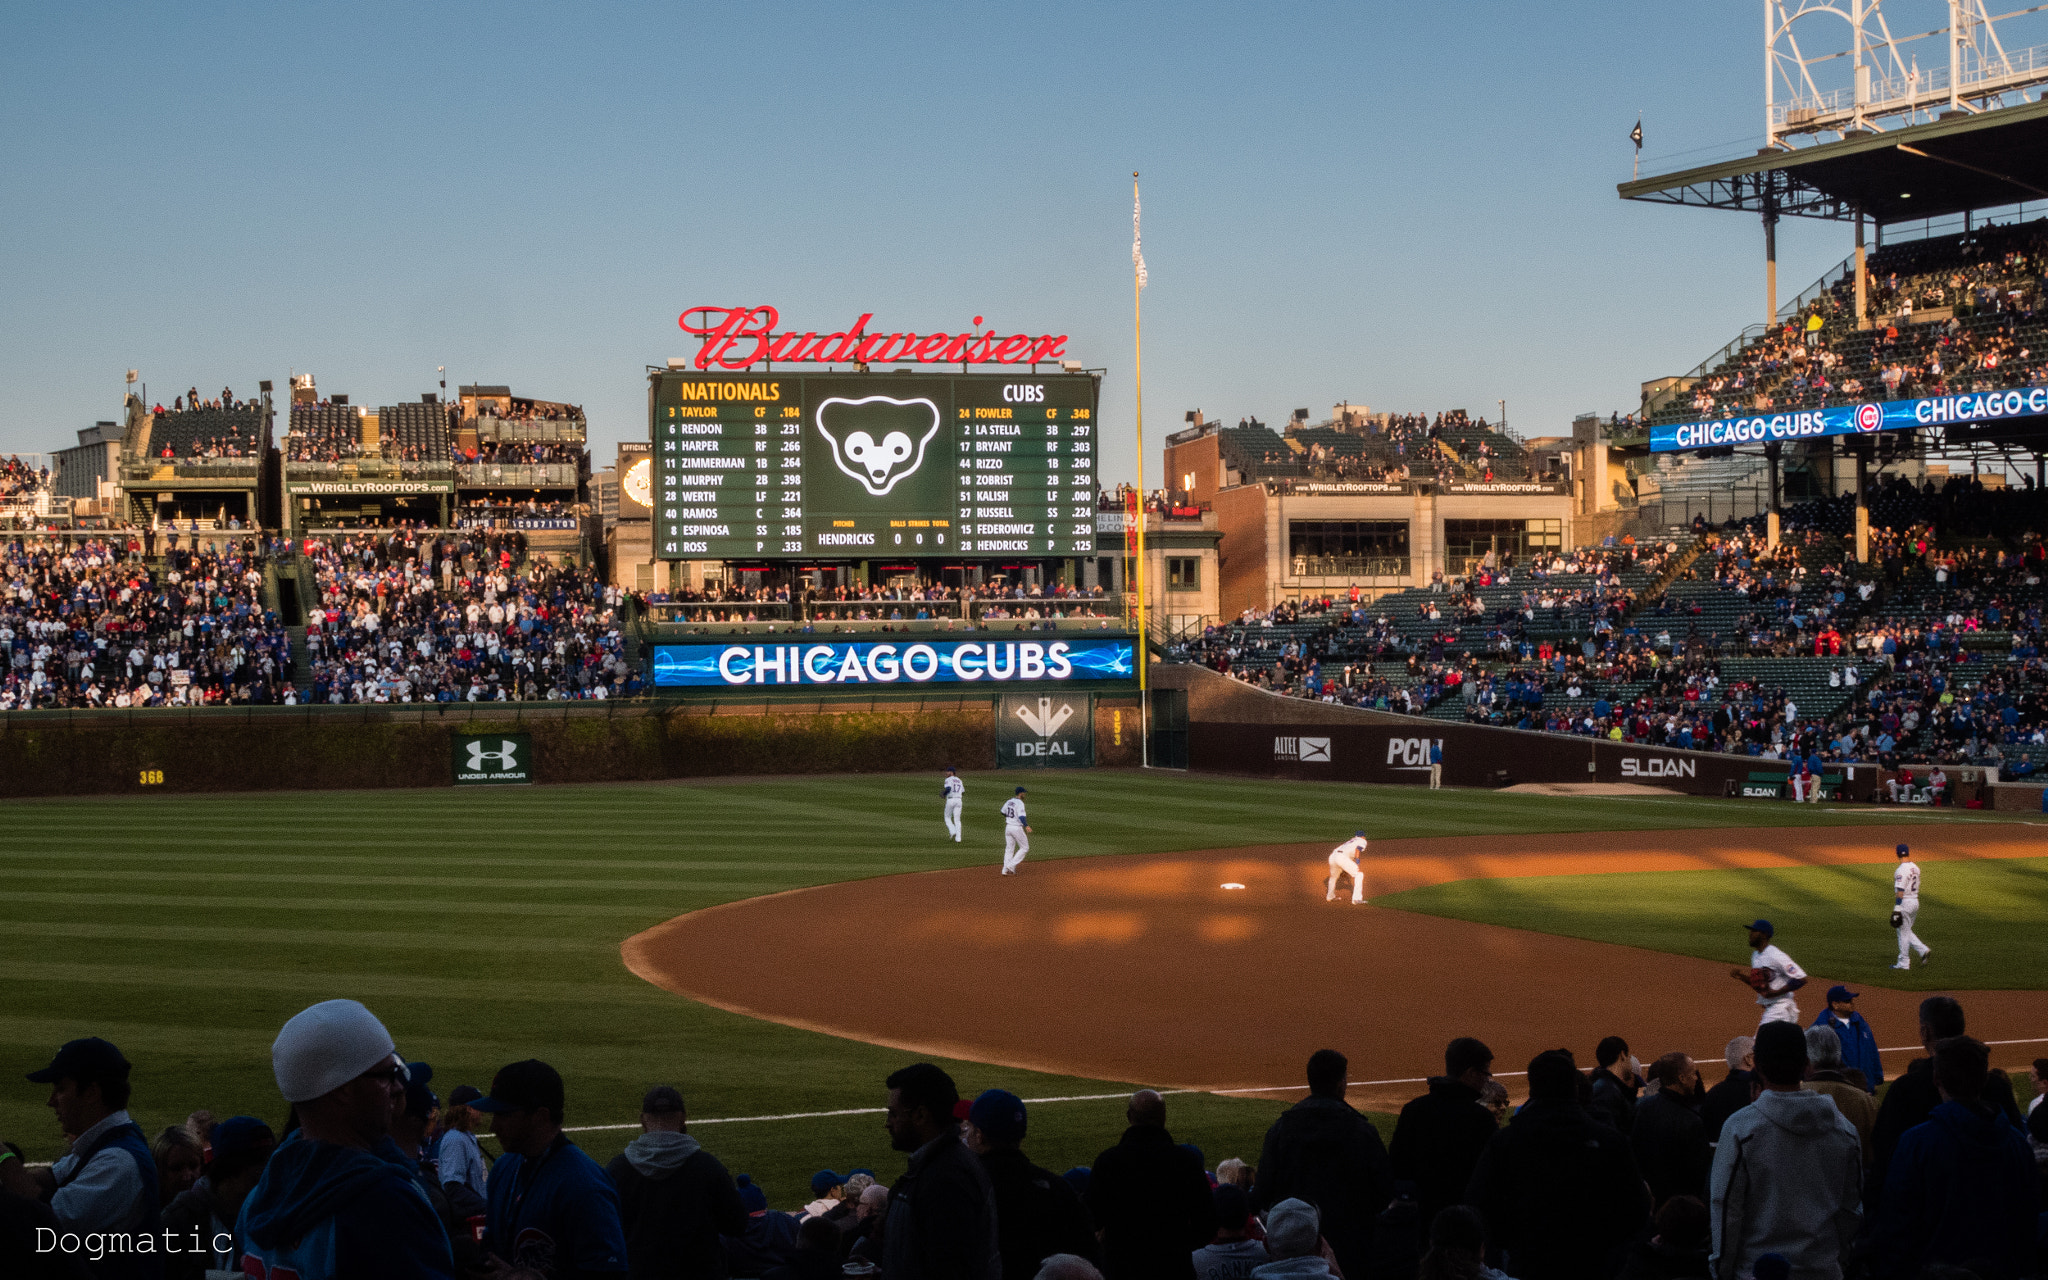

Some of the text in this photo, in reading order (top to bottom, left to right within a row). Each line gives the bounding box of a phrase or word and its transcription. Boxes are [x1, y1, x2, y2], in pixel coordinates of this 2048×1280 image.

[678, 305, 1068, 370] Budweiser
[683, 383, 779, 400] NATIONALS
[1004, 385, 1044, 402] CUBS
[669, 407, 800, 417] 3 TAYLOR CF .184
[1915, 391, 2023, 424] CHICAGO
[959, 408, 1089, 419] 24 FOWLER CF .348
[670, 424, 799, 434] 6 RENDON 3B .231
[965, 425, 1089, 436] 2 LA STELLA 3B .297
[1676, 411, 1825, 447] CHICAGO CUBS
[665, 441, 800, 451] 34 HARPER RF .266
[960, 442, 1090, 452] 17 BRYANT RF .303
[665, 458, 801, 468] 11 ZIMMERMAN 1B .264
[960, 458, 1090, 469] 44 RIZZO 1B .260
[665, 475, 801, 485] 20 MURPHY 2B .398
[961, 475, 1090, 485] 18 ZOBRIST 2B .250
[666, 491, 800, 501] 28 WERTH LF .221
[961, 491, 1090, 501] 51 KALISH LF .000
[666, 508, 801, 518] 40 RAMOS C .364
[961, 507, 1091, 517] 27 RUSSELL SS .224
[671, 525, 801, 535] 8 ESPINOSA SS .185
[961, 524, 1091, 534] 15 FEDEROWICZ C .250
[819, 534, 874, 544] HENDRICKS
[895, 534, 944, 544] 0 0 0
[666, 542, 801, 552] 41 ROSS P .333
[961, 540, 1091, 550] 28 HENDRICKS P .125
[718, 642, 1072, 684] CHICAGO CUBS
[1016, 741, 1075, 756] IDEAL
[1274, 737, 1297, 754] ALTEC
[1621, 758, 1695, 777] SLOAN
[140, 771, 163, 784] 368
[953, 784, 960, 793] 17
[1743, 788, 1776, 797] SLOAN
[1007, 807, 1015, 818] 13
